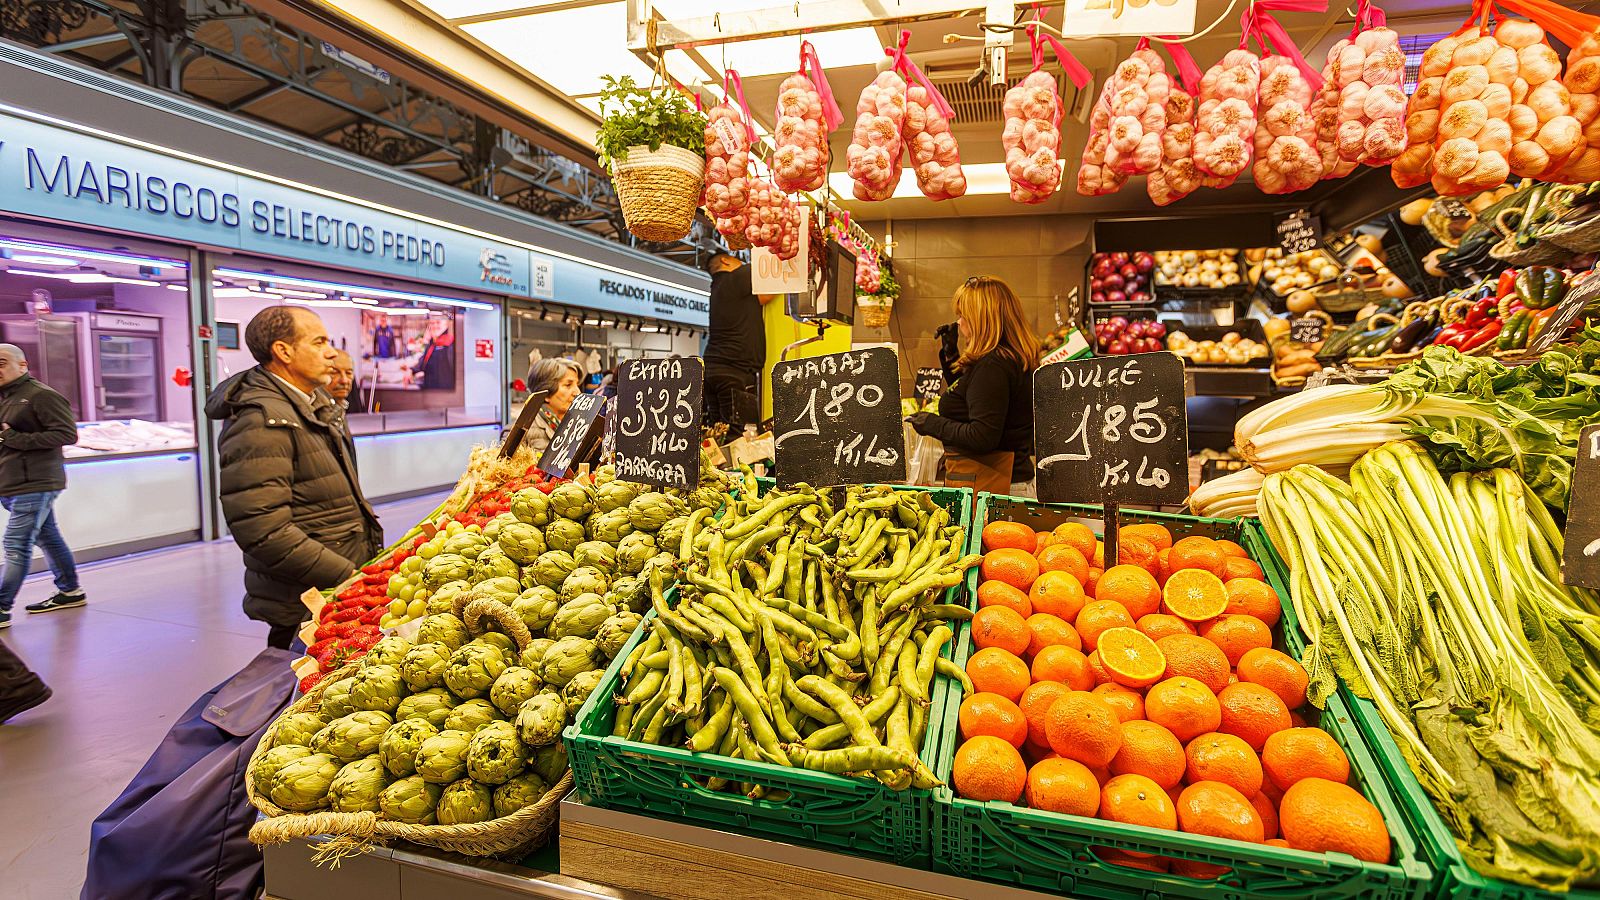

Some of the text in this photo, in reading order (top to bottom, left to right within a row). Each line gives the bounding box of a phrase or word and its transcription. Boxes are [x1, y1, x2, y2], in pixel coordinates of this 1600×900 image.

[24, 147, 446, 267] MARISCOS SELECTOS PEDRO
[600, 278, 644, 301] PESCADOS
[646, 289, 652, 302] Y
[653, 291, 687, 309] MARISCOS
[628, 360, 682, 381] EXTRA
[782, 352, 873, 384] HABAS
[1060, 360, 1143, 390] DULCE
[620, 382, 694, 437] 3'25
[774, 379, 884, 449] 1'80
[1037, 396, 1167, 469] 1'85
[616, 452, 687, 485] ZARAGOZA
